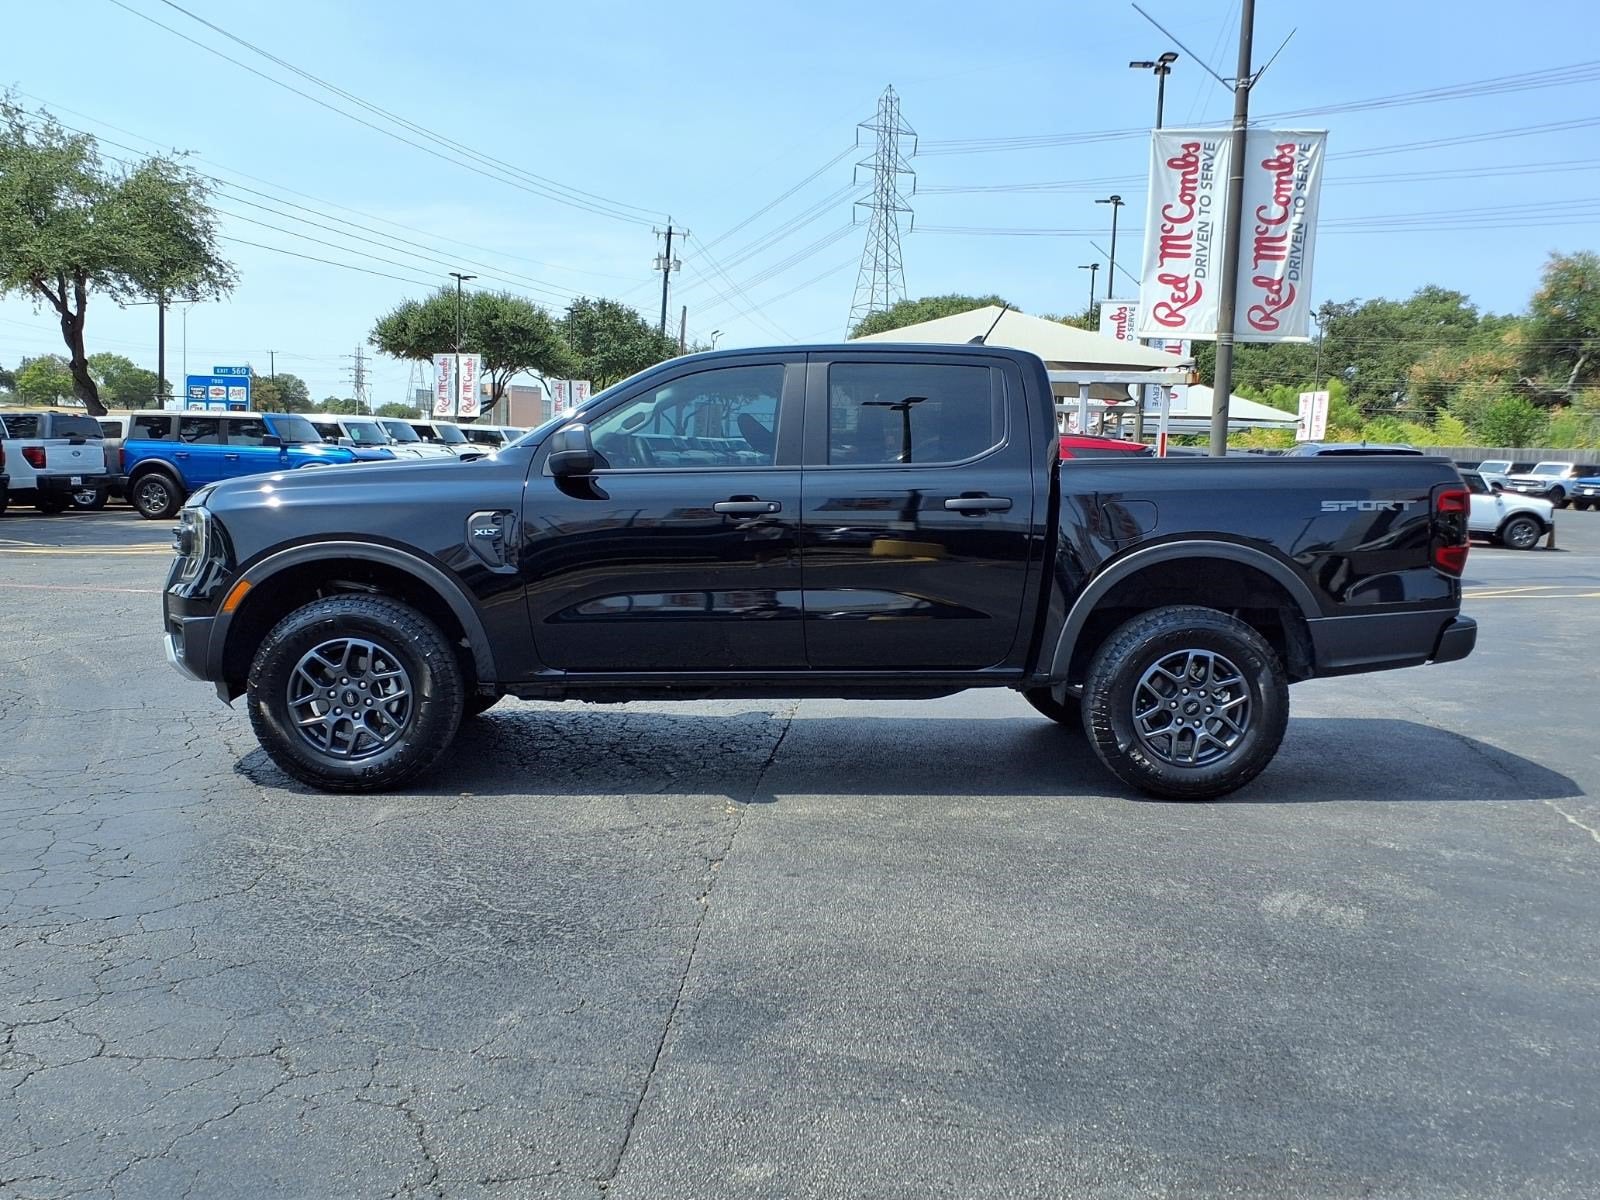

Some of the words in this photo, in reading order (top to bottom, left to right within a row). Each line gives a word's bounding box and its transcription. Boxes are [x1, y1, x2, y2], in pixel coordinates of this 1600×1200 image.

[1201, 142, 1215, 190] SERVE
[1296, 143, 1311, 191] SERVE
[1158, 142, 1201, 268] McCombs
[1199, 196, 1211, 216] TO
[1252, 143, 1296, 270] McCombs
[1293, 197, 1306, 217] TO
[1195, 222, 1210, 279] DRIVEN
[1288, 223, 1304, 281] DRIVEN
[1110, 306, 1127, 340] ombs
[1127, 306, 1136, 332] SERVE
[1153, 273, 1203, 327] Red
[1248, 276, 1296, 331] Red
[231, 367, 247, 375] 560
[1319, 499, 1418, 512] SPORT
[474, 528, 499, 536] XLT
